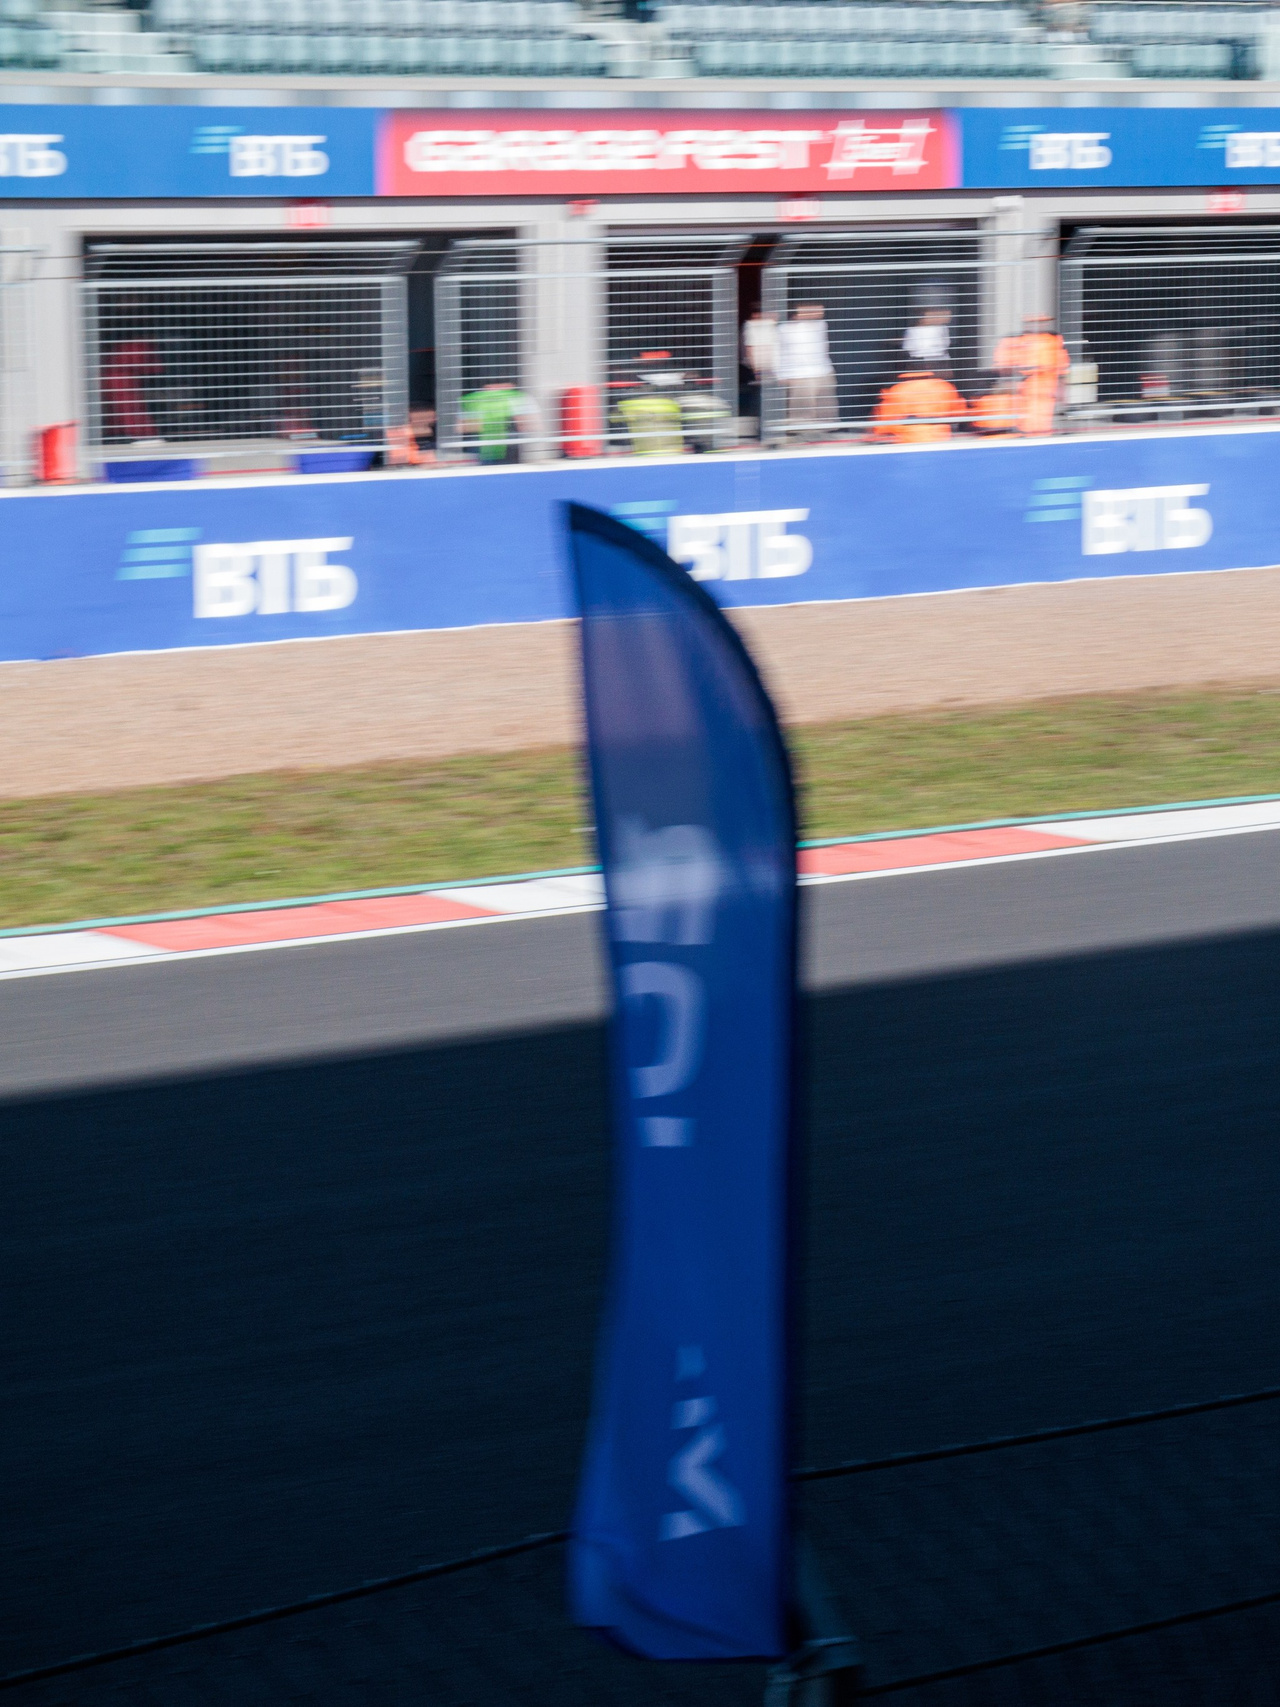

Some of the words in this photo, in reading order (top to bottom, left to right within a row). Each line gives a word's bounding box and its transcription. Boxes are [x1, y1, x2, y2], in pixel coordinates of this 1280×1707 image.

[0, 133, 67, 177] ТБ
[229, 135, 329, 177] ВТБ
[1029, 132, 1111, 170] ВТБ
[1081, 483, 1213, 555] ВТБ
[193, 536, 358, 618] ВТБ
